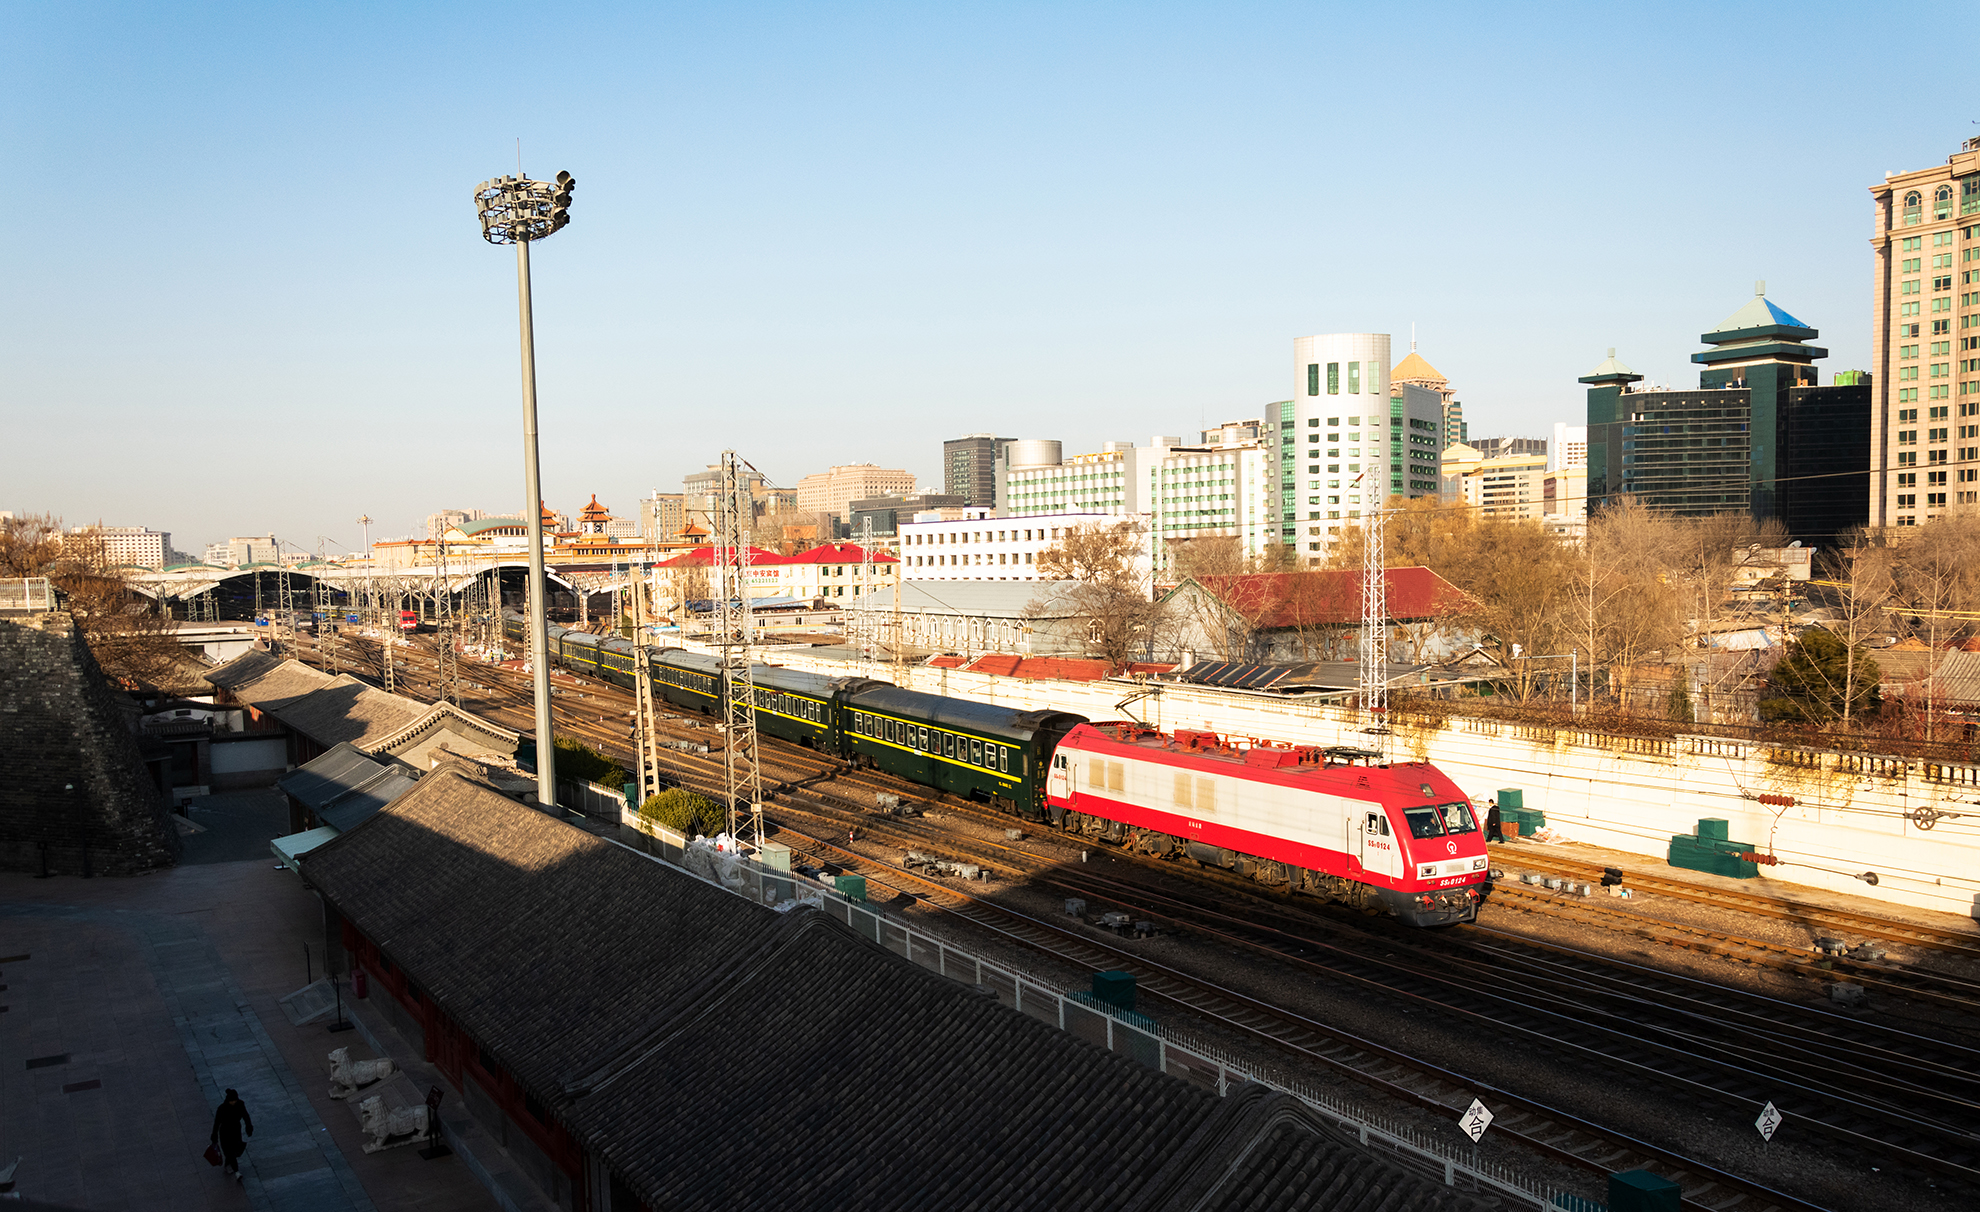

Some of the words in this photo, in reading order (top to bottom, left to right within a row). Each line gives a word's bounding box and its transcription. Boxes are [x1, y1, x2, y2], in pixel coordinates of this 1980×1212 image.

[745, 570, 779, 578] 中安宾馆
[1469, 1116, 1484, 1137] 合
[1763, 1117, 1775, 1136] 合
